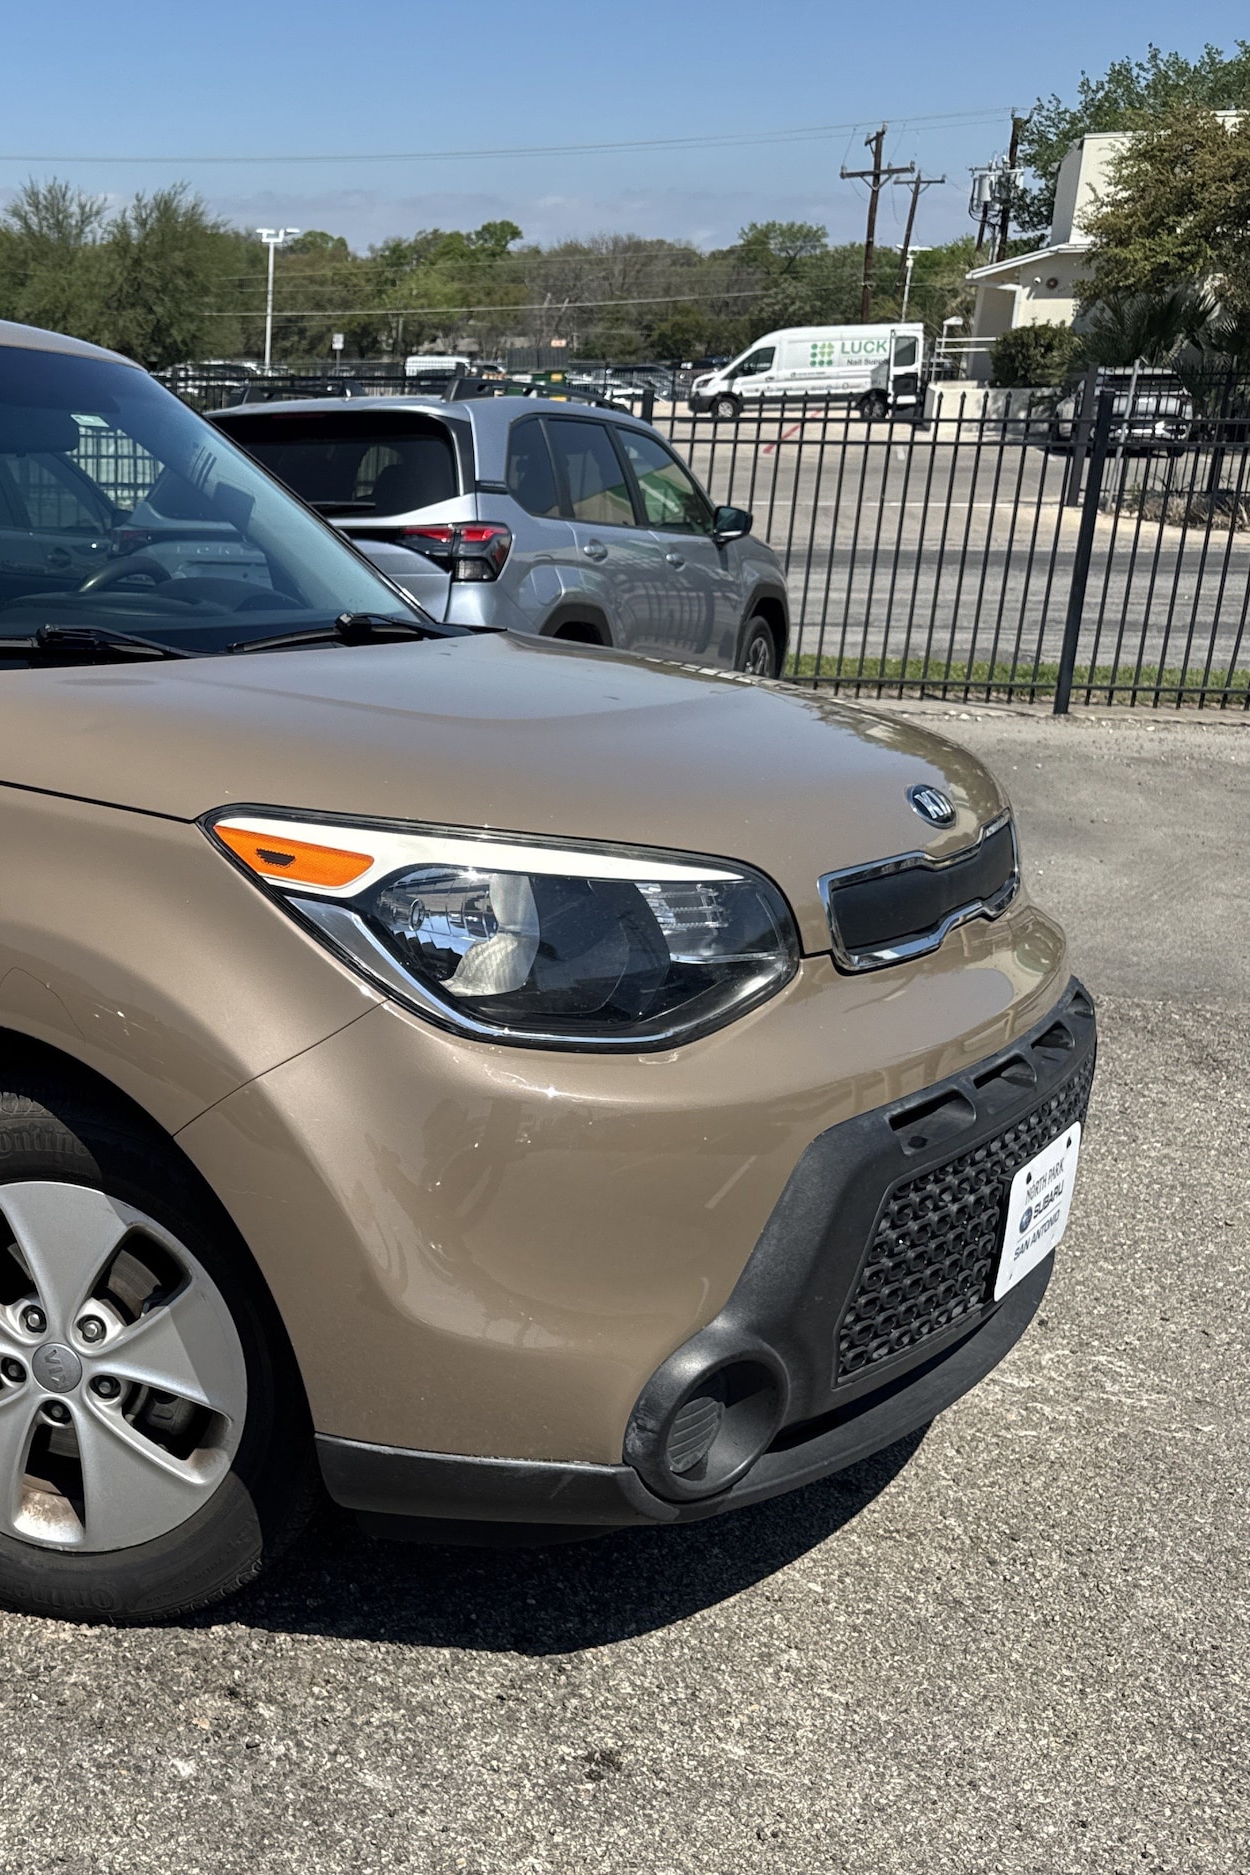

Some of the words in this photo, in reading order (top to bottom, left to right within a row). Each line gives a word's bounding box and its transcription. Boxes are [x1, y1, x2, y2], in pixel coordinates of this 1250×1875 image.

[846, 357, 863, 367] Nail
[1024, 1174, 1047, 1206] NORTH
[1047, 1157, 1065, 1184] PARK
[1033, 1180, 1065, 1220] SUBARU
[1013, 1238, 1031, 1261] SAN
[1031, 1209, 1060, 1244] ANTONIO
